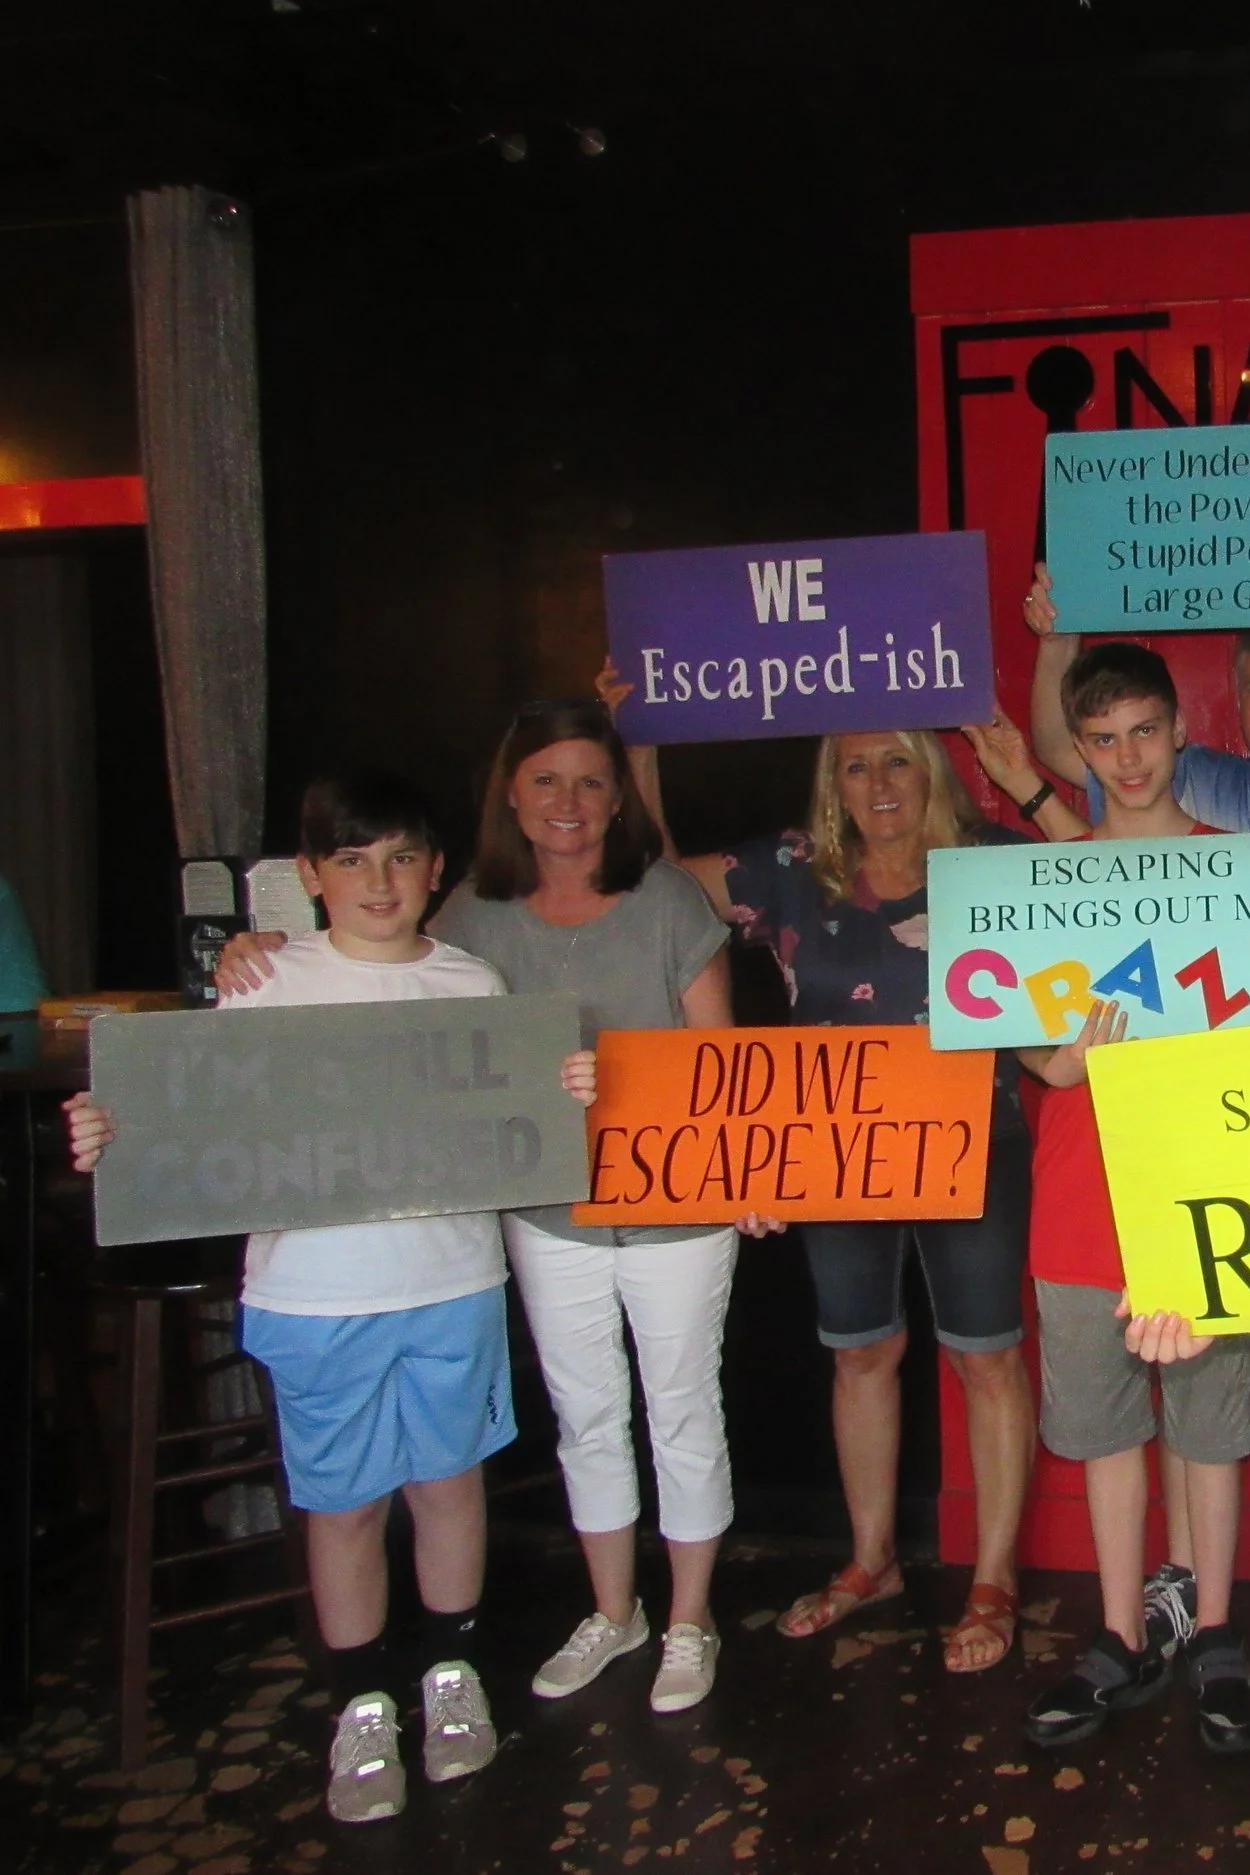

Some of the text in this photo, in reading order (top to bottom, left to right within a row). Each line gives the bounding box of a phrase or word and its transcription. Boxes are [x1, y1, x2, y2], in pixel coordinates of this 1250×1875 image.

[1054, 452, 1155, 484] Never
[1126, 494, 1182, 526] the
[1107, 535, 1217, 576] Stupid
[748, 558, 826, 624] WE
[1122, 583, 1224, 621] Large
[641, 621, 965, 721] Escaped-ish
[1030, 849, 1235, 887] ESCAPING
[968, 898, 1122, 934] BRINGS
[1134, 893, 1219, 926] OUT
[164, 1034, 271, 1109] I'M
[688, 1040, 890, 1117] DID WE
[138, 1115, 543, 1203] CONFUSED
[589, 1119, 972, 1205] ESCAPE YET?
